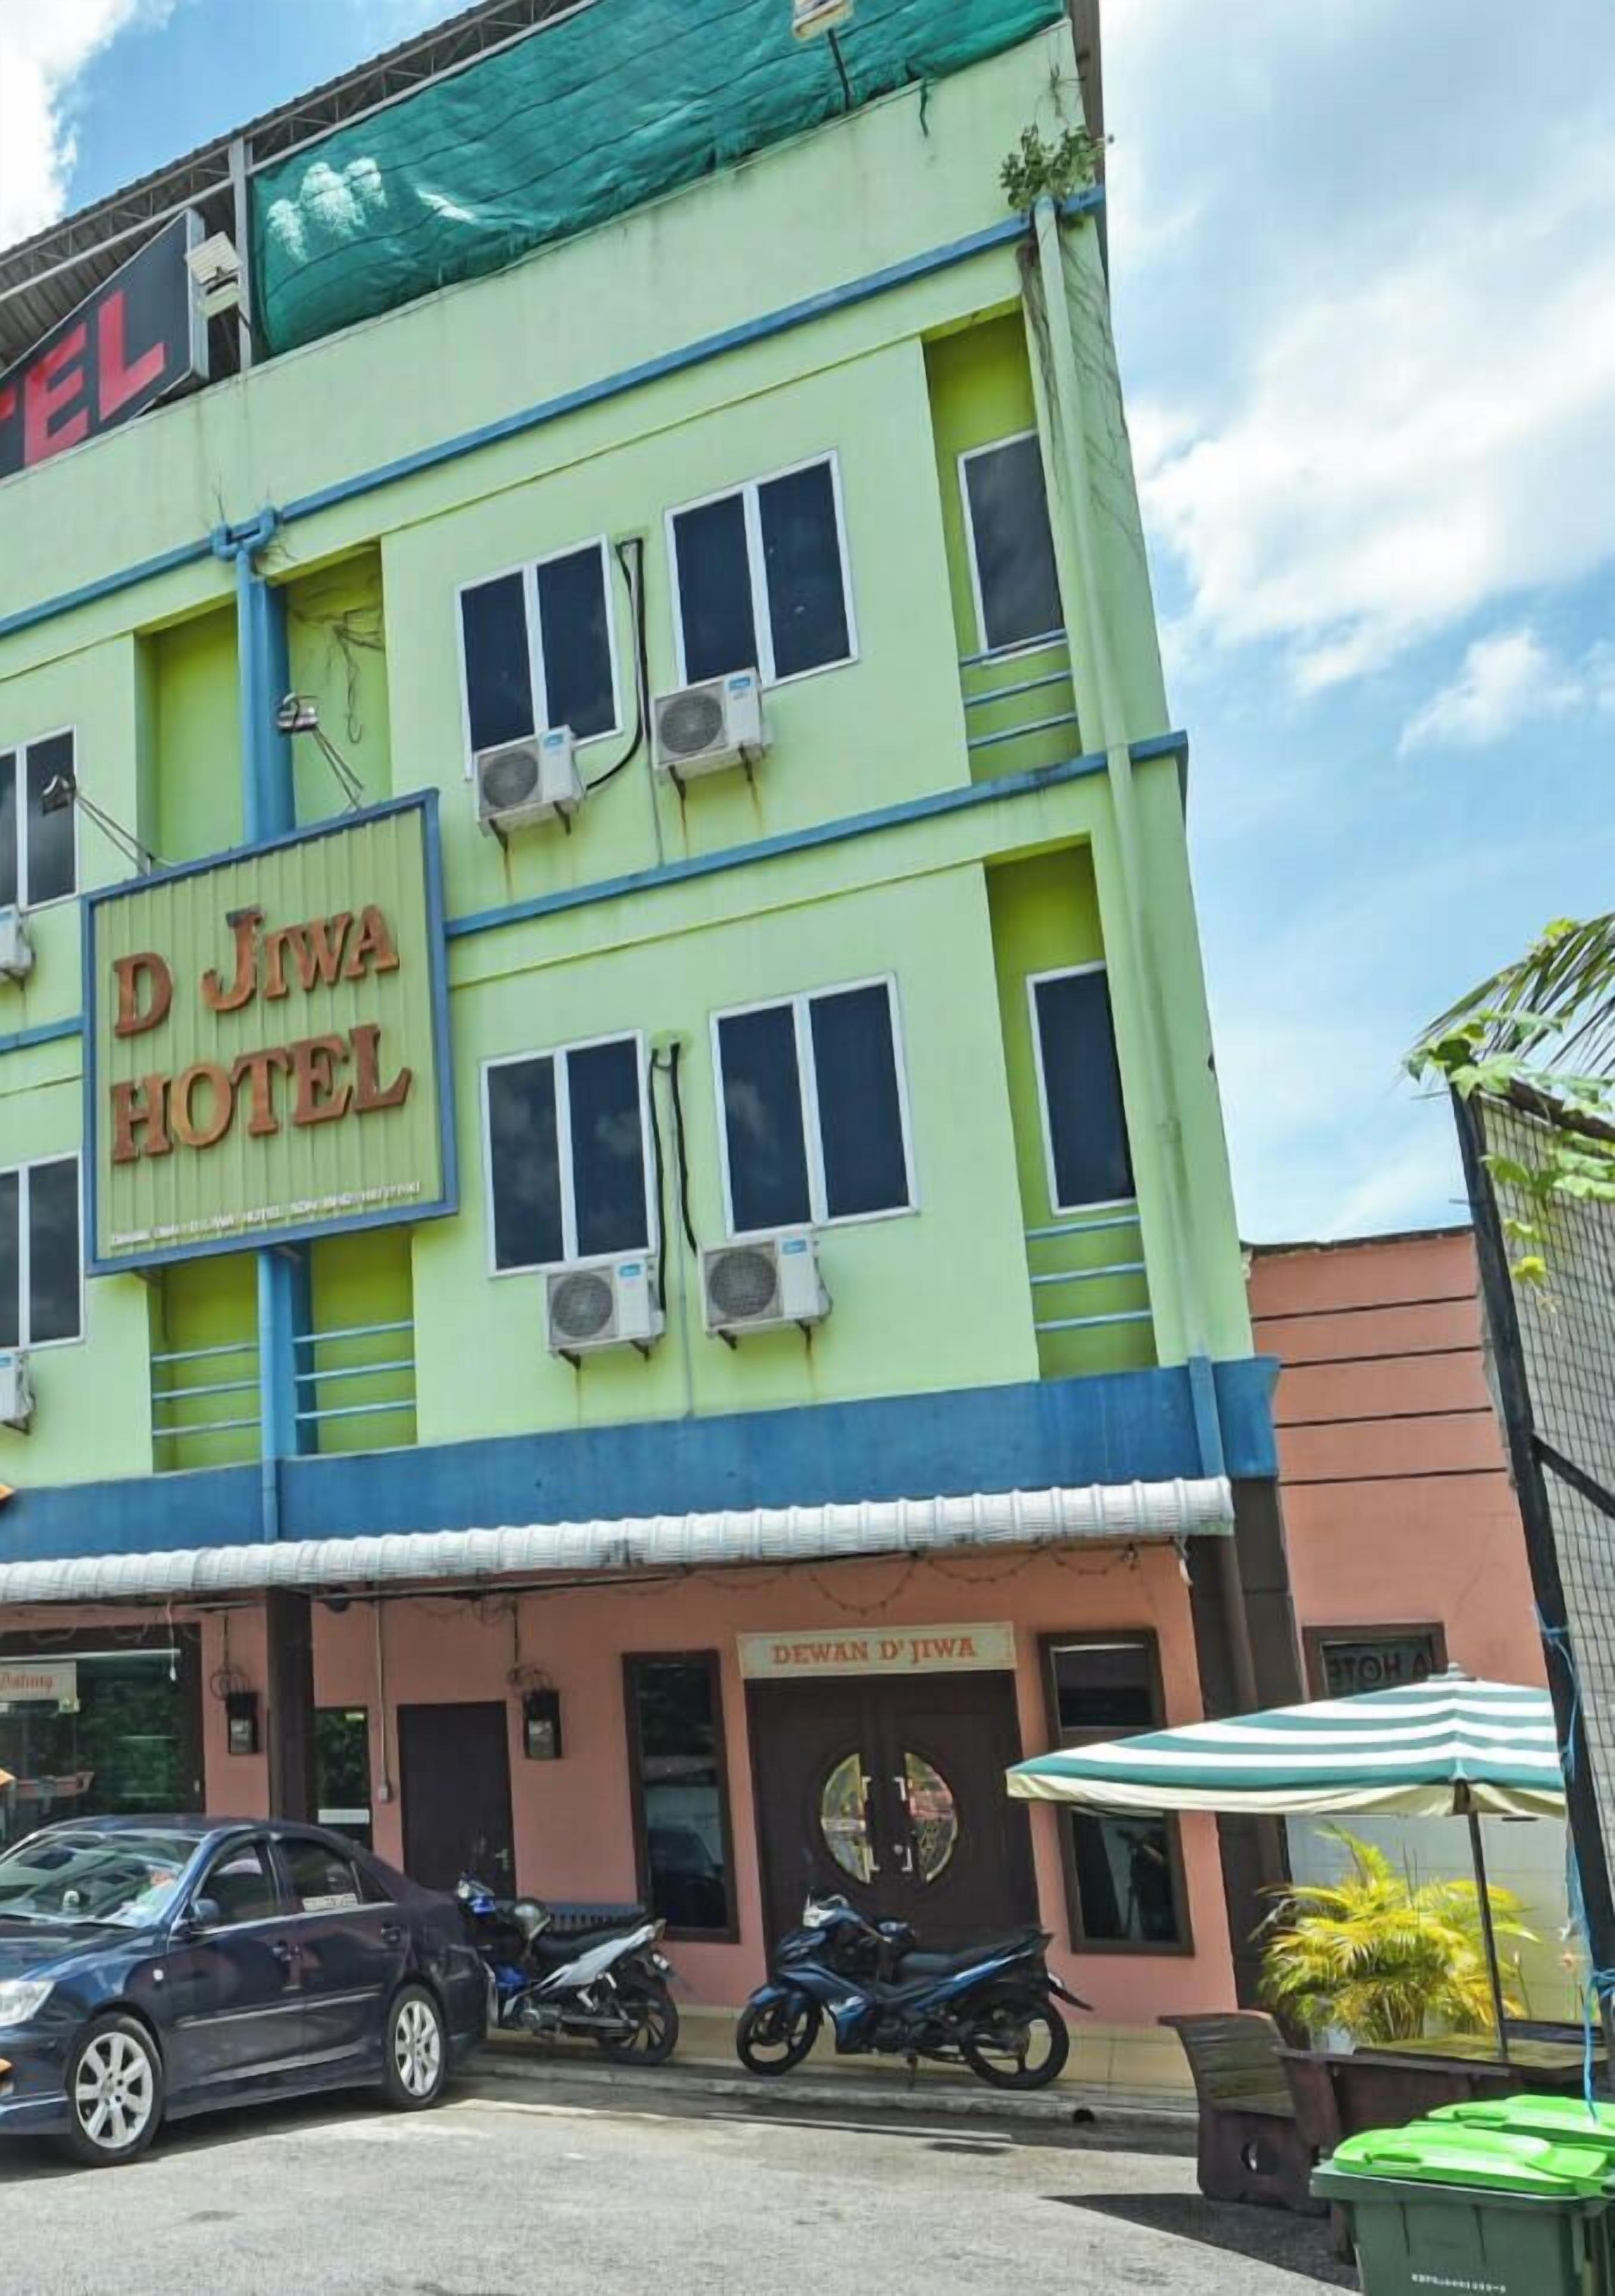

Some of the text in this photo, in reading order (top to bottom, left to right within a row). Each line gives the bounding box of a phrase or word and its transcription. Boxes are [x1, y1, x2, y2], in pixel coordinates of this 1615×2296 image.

[113, 904, 400, 1038] D JIWA
[110, 1023, 412, 1165] HOTEL
[771, 1639, 869, 1665] DEWAN
